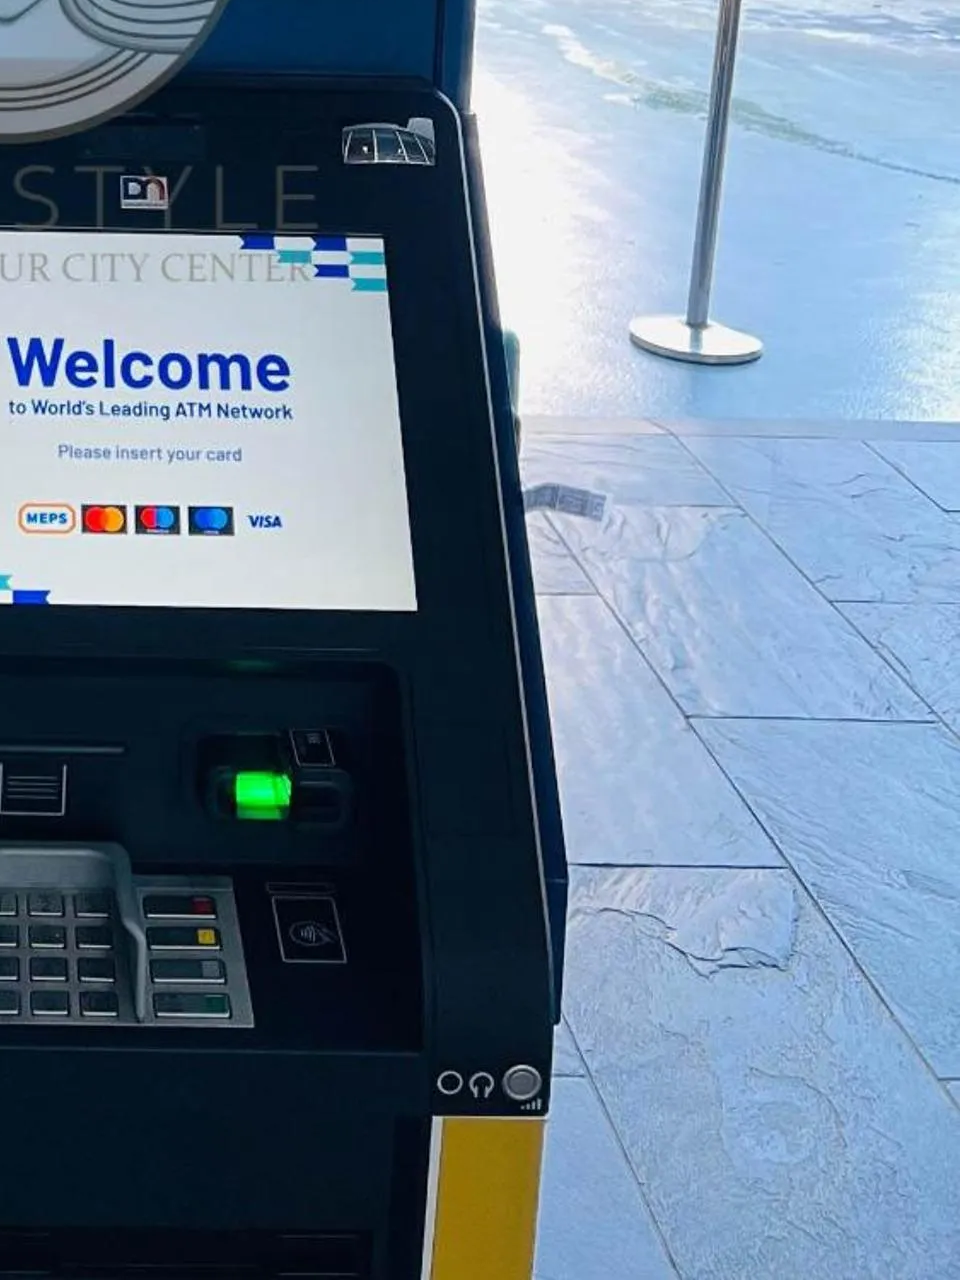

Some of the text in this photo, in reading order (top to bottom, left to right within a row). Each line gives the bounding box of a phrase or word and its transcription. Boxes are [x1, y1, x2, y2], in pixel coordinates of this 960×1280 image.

[7, 337, 291, 391] Welcome
[9, 399, 293, 421] to World's Leading ATM Network
[58, 444, 243, 464] Please insert your card
[26, 512, 68, 525] MEPS
[247, 515, 283, 528] VISA
